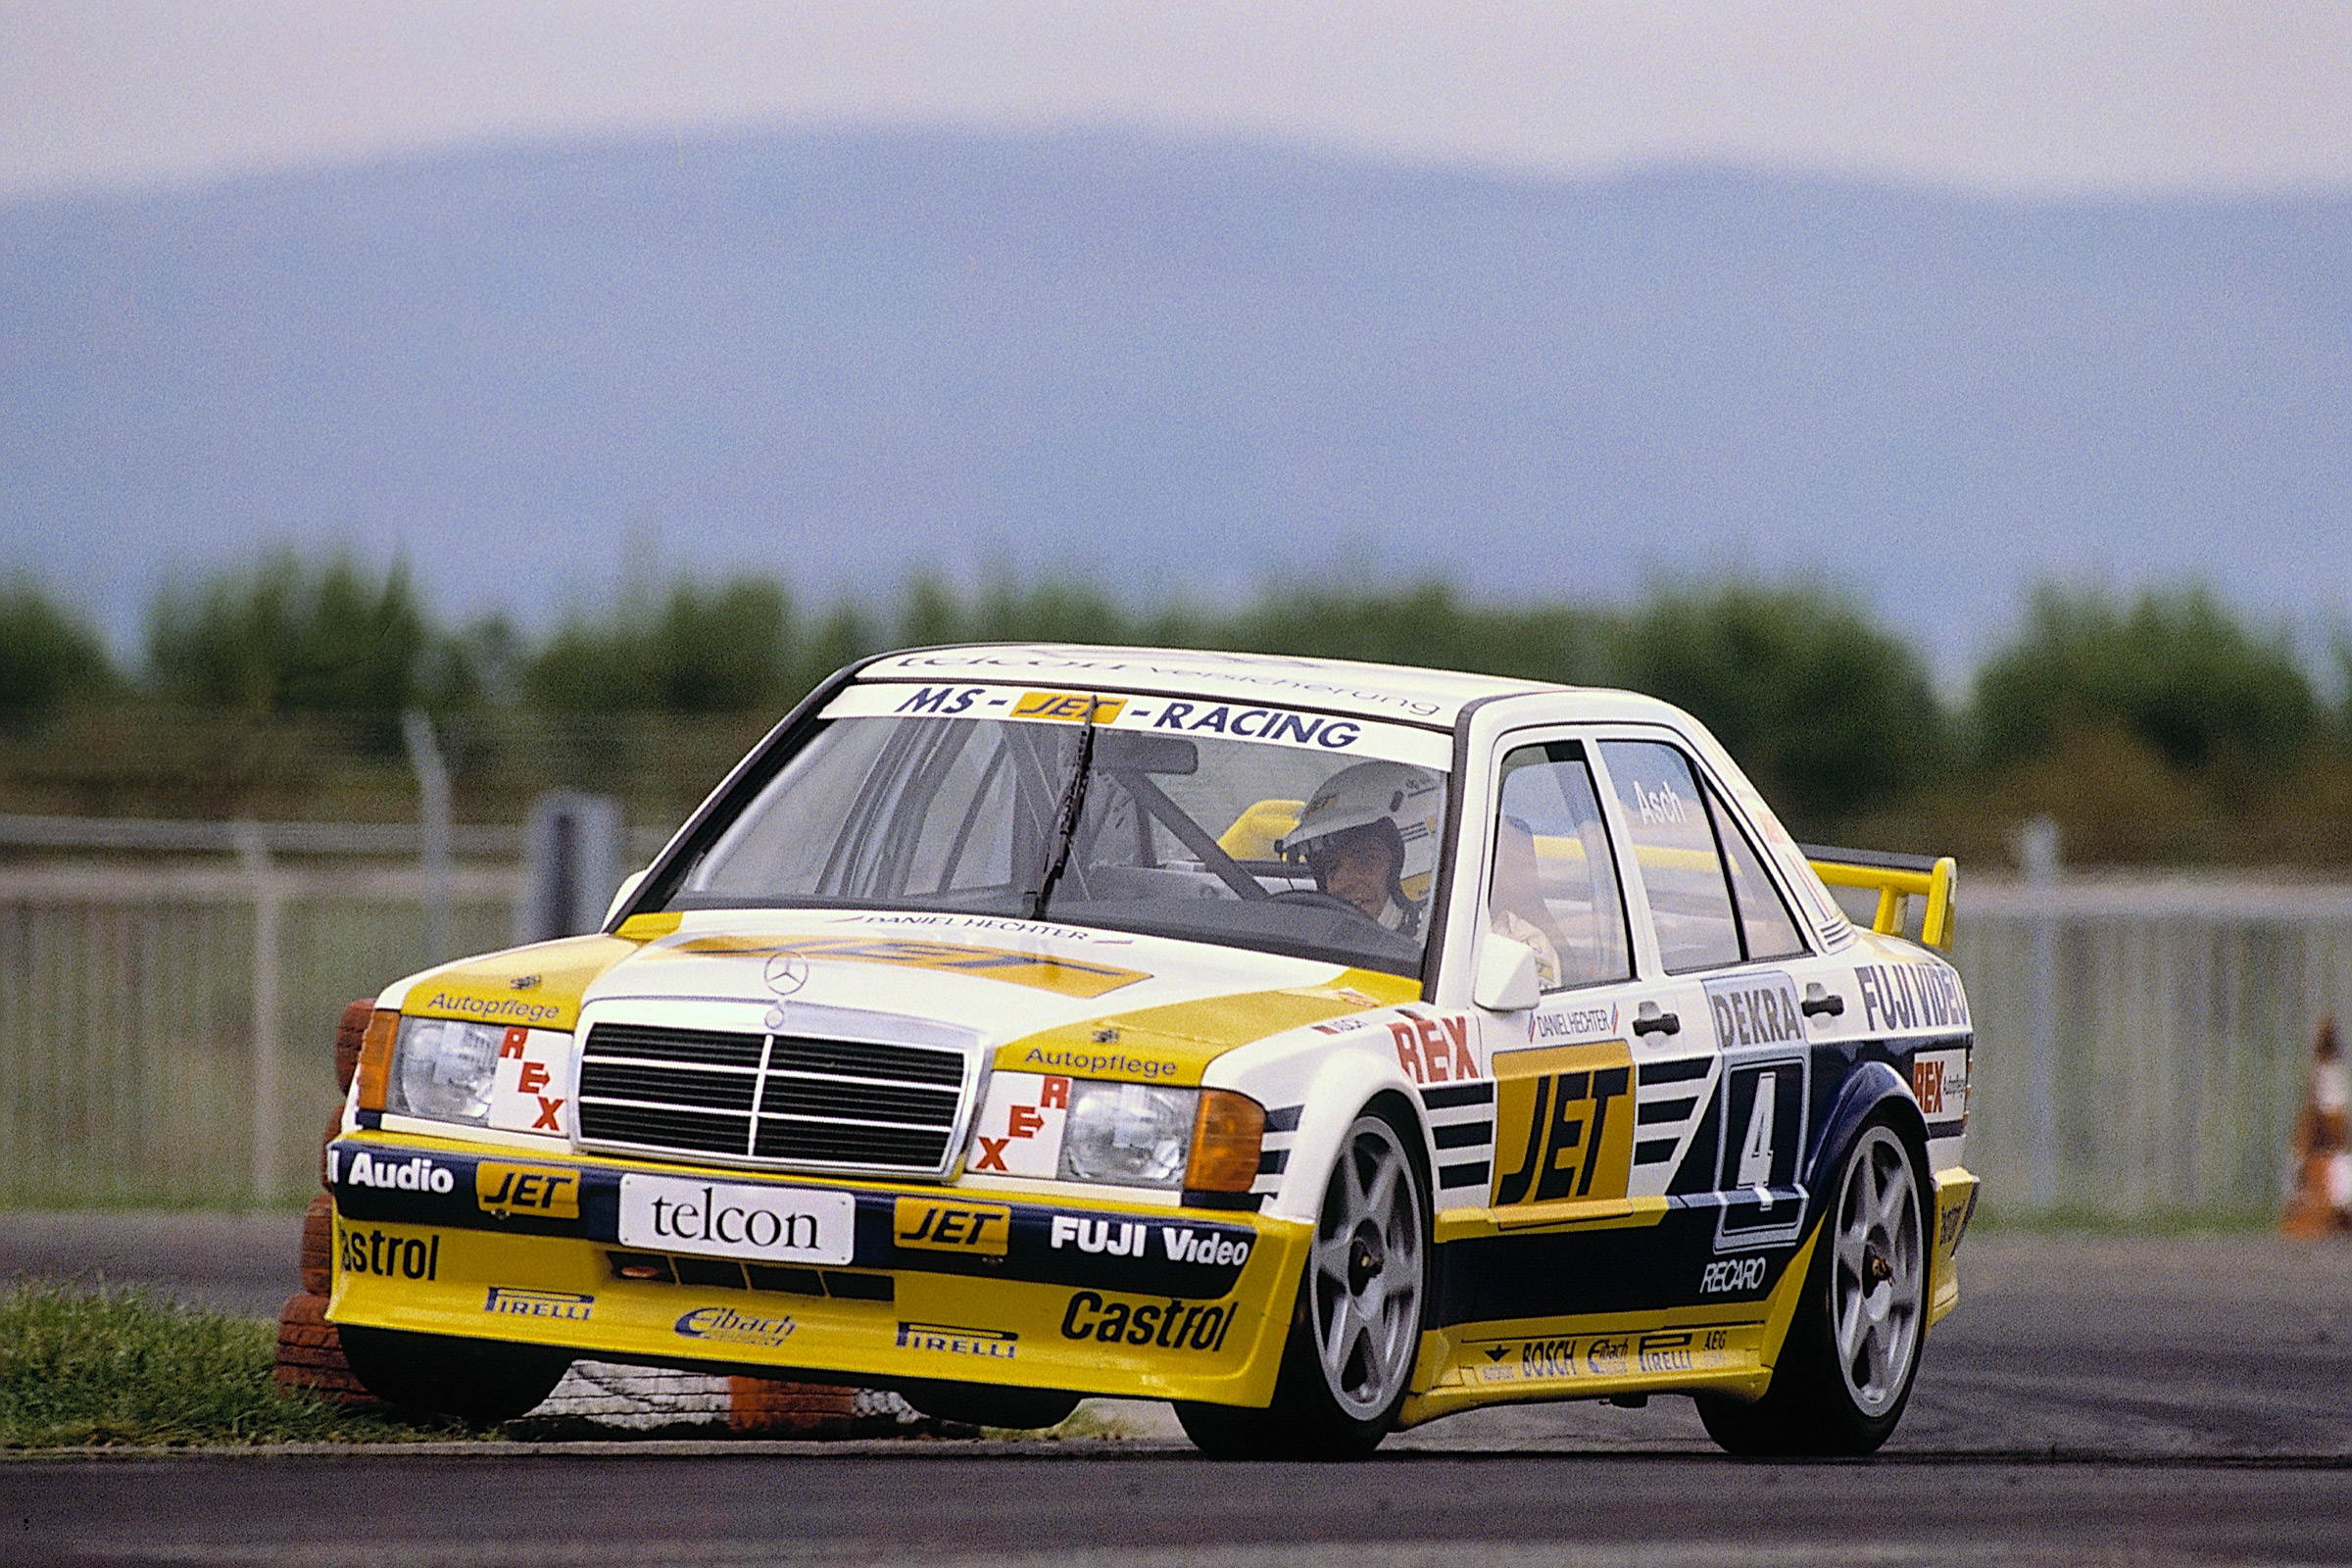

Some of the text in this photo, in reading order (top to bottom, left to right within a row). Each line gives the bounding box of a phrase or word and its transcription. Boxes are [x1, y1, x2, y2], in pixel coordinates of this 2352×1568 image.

[1015, 696, 1120, 717] JET
[1634, 780, 1687, 824] Asch
[866, 916, 1089, 941] DANIEL HECHTER
[427, 991, 561, 1021] Autopflege
[1711, 986, 1802, 1048] DEKRA
[1854, 964, 1918, 1032] FUJI
[1537, 1009, 1611, 1038] DANIEL HECHTER
[1024, 1048, 1177, 1078] Autopflege
[1387, 1015, 1480, 1085] REX
[1914, 1060, 1944, 1113] REX
[1495, 1066, 1631, 1207] JET
[1736, 1071, 1777, 1212] 4
[348, 1152, 455, 1194] Audio
[483, 1171, 573, 1209] JET
[651, 1187, 821, 1250] telcon
[900, 1207, 1003, 1246] JET
[340, 1229, 440, 1281] strol
[1051, 1215, 1250, 1267] FUJI Video
[1699, 1256, 1767, 1294] RECARO
[484, 1286, 596, 1320] PIRELLI
[673, 1306, 796, 1339] Eibach
[1060, 1290, 1239, 1352] Castrol
[896, 1321, 1019, 1359] PIRELLI
[1522, 1340, 1577, 1377] BOSCH
[1638, 1333, 1692, 1372] PIRELLI
[1702, 1330, 1727, 1351] AEG
